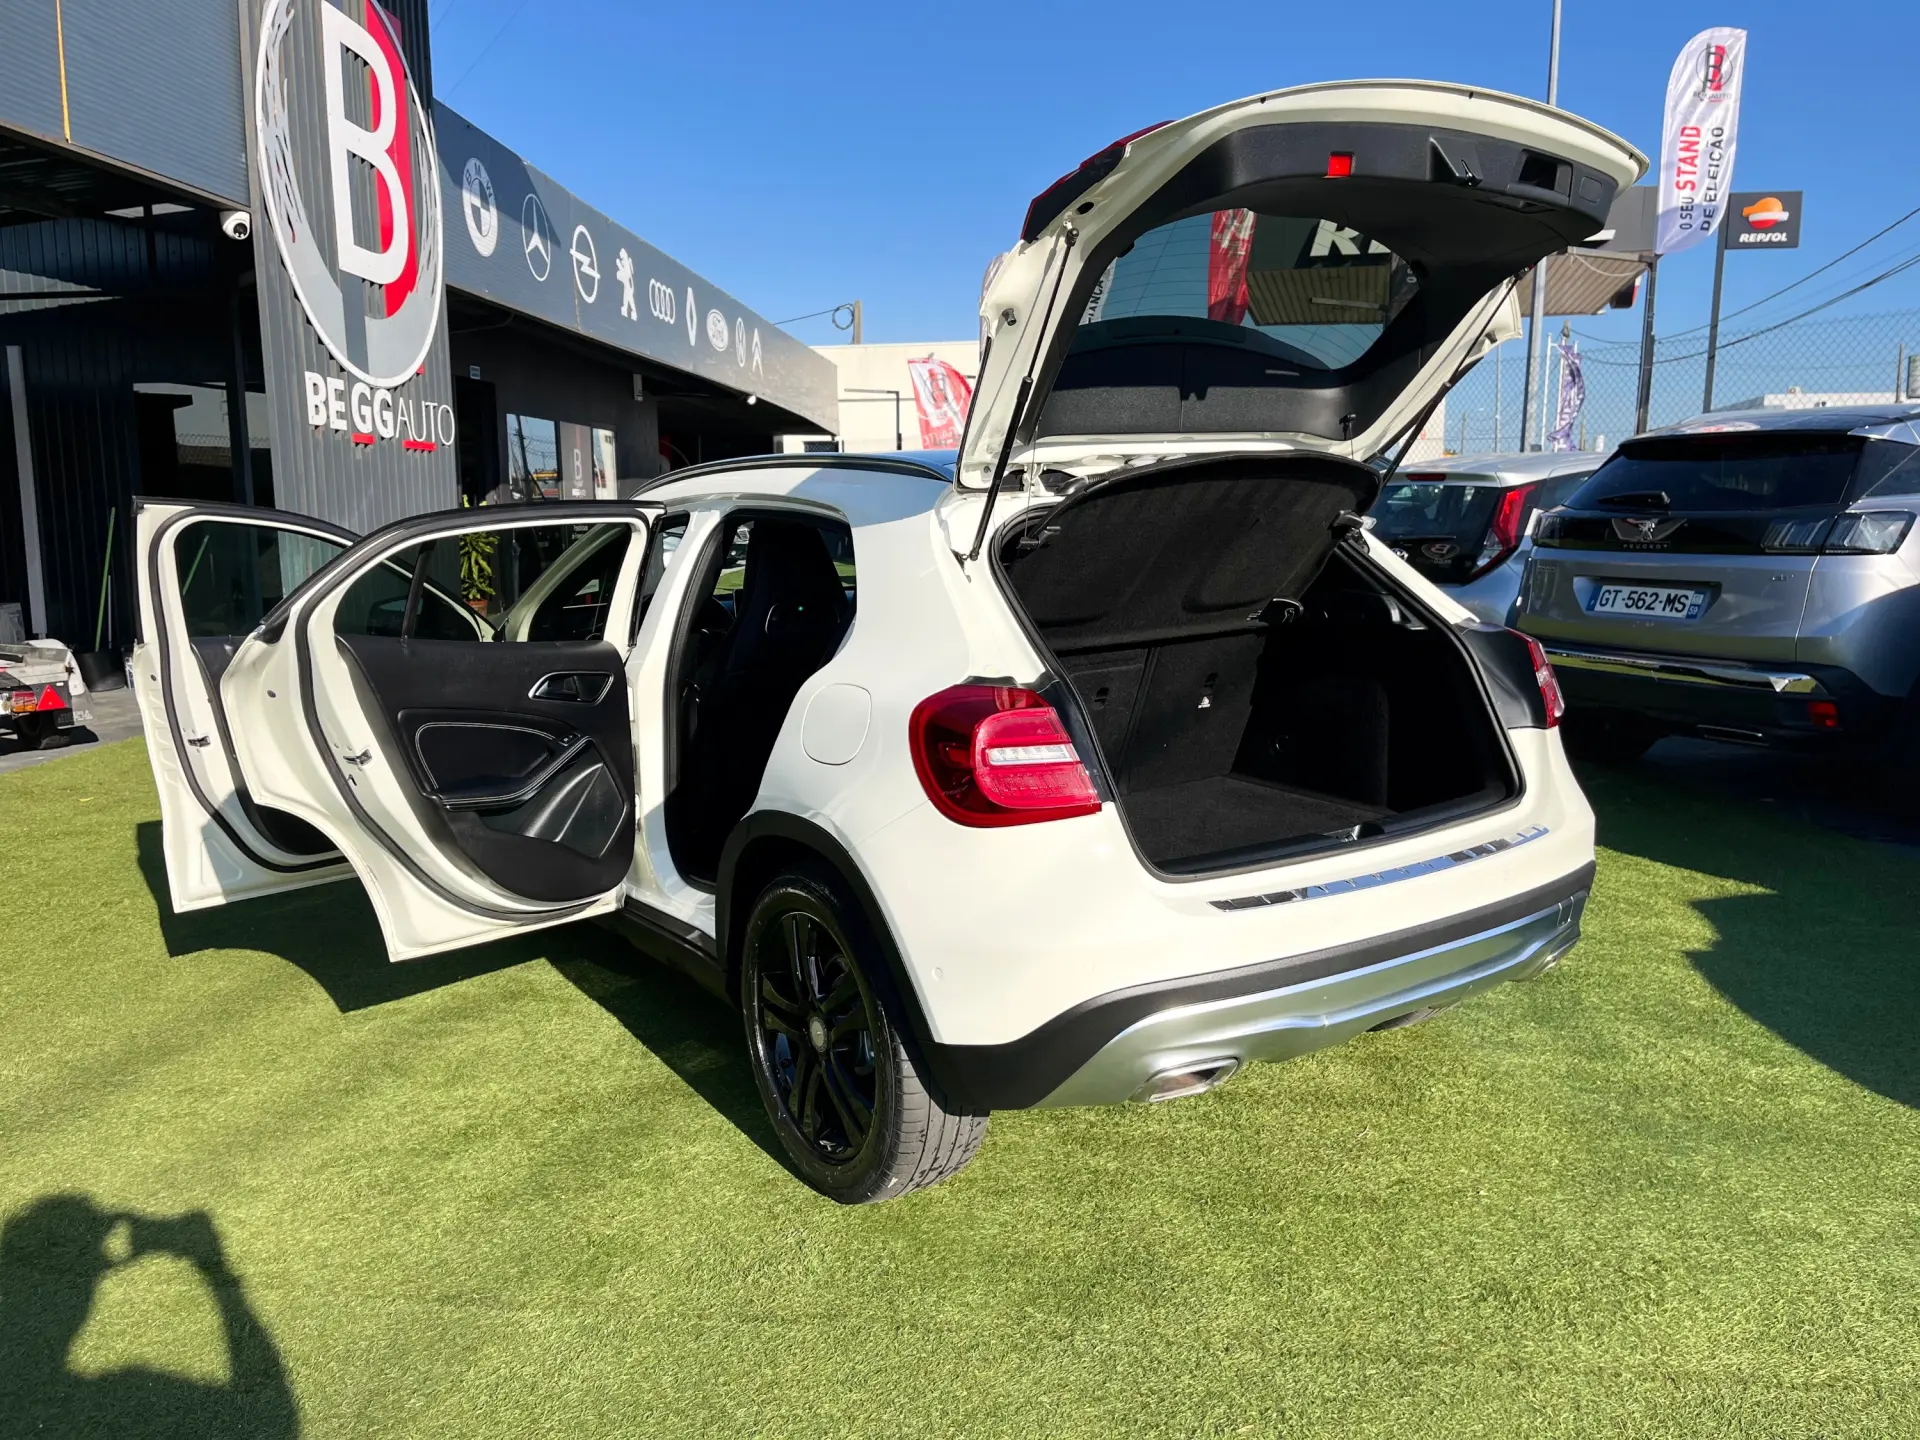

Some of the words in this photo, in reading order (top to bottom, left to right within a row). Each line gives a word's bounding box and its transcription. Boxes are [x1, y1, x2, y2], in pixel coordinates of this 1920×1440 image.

[322, 0, 409, 285] B
[1675, 125, 1701, 191] STAND
[1680, 196, 1695, 219] SEU
[1700, 207, 1715, 231] DE
[1739, 232, 1788, 242] REPSOL
[1599, 589, 1690, 614] GT-562-MS
